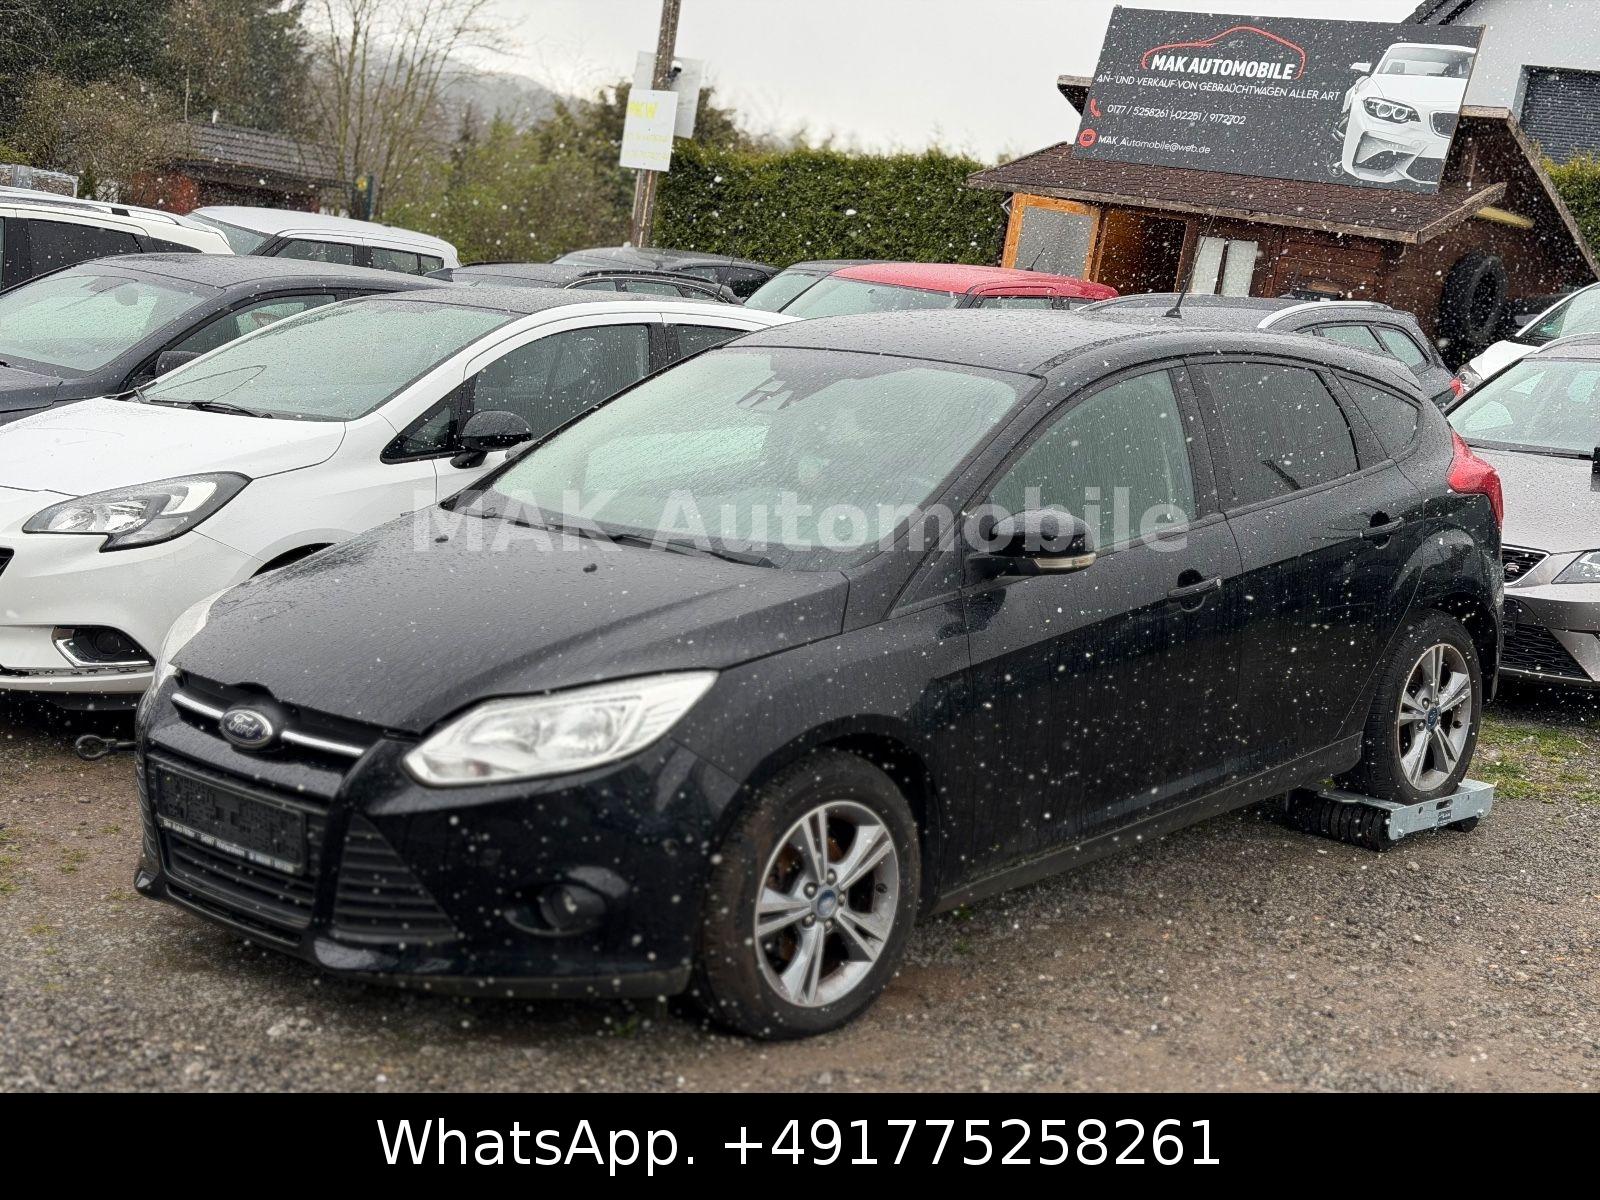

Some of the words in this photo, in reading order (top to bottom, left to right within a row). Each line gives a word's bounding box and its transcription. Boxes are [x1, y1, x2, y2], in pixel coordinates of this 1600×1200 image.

[1151, 55, 1188, 73] MAK
[1187, 57, 1296, 80] AUTOMOBILE
[1115, 75, 1135, 86] UND
[1137, 77, 1177, 89] VERKAUF
[1177, 80, 1199, 91] VON
[1199, 81, 1288, 98] GEBRAUCHTWAGEN
[1288, 88, 1320, 100] ALLER
[1320, 91, 1341, 101] ART
[1107, 104, 1127, 114] 0177
[1133, 106, 1170, 118] 5258261
[1209, 113, 1247, 125] 9172702
[228, 713, 259, 738] Ford
